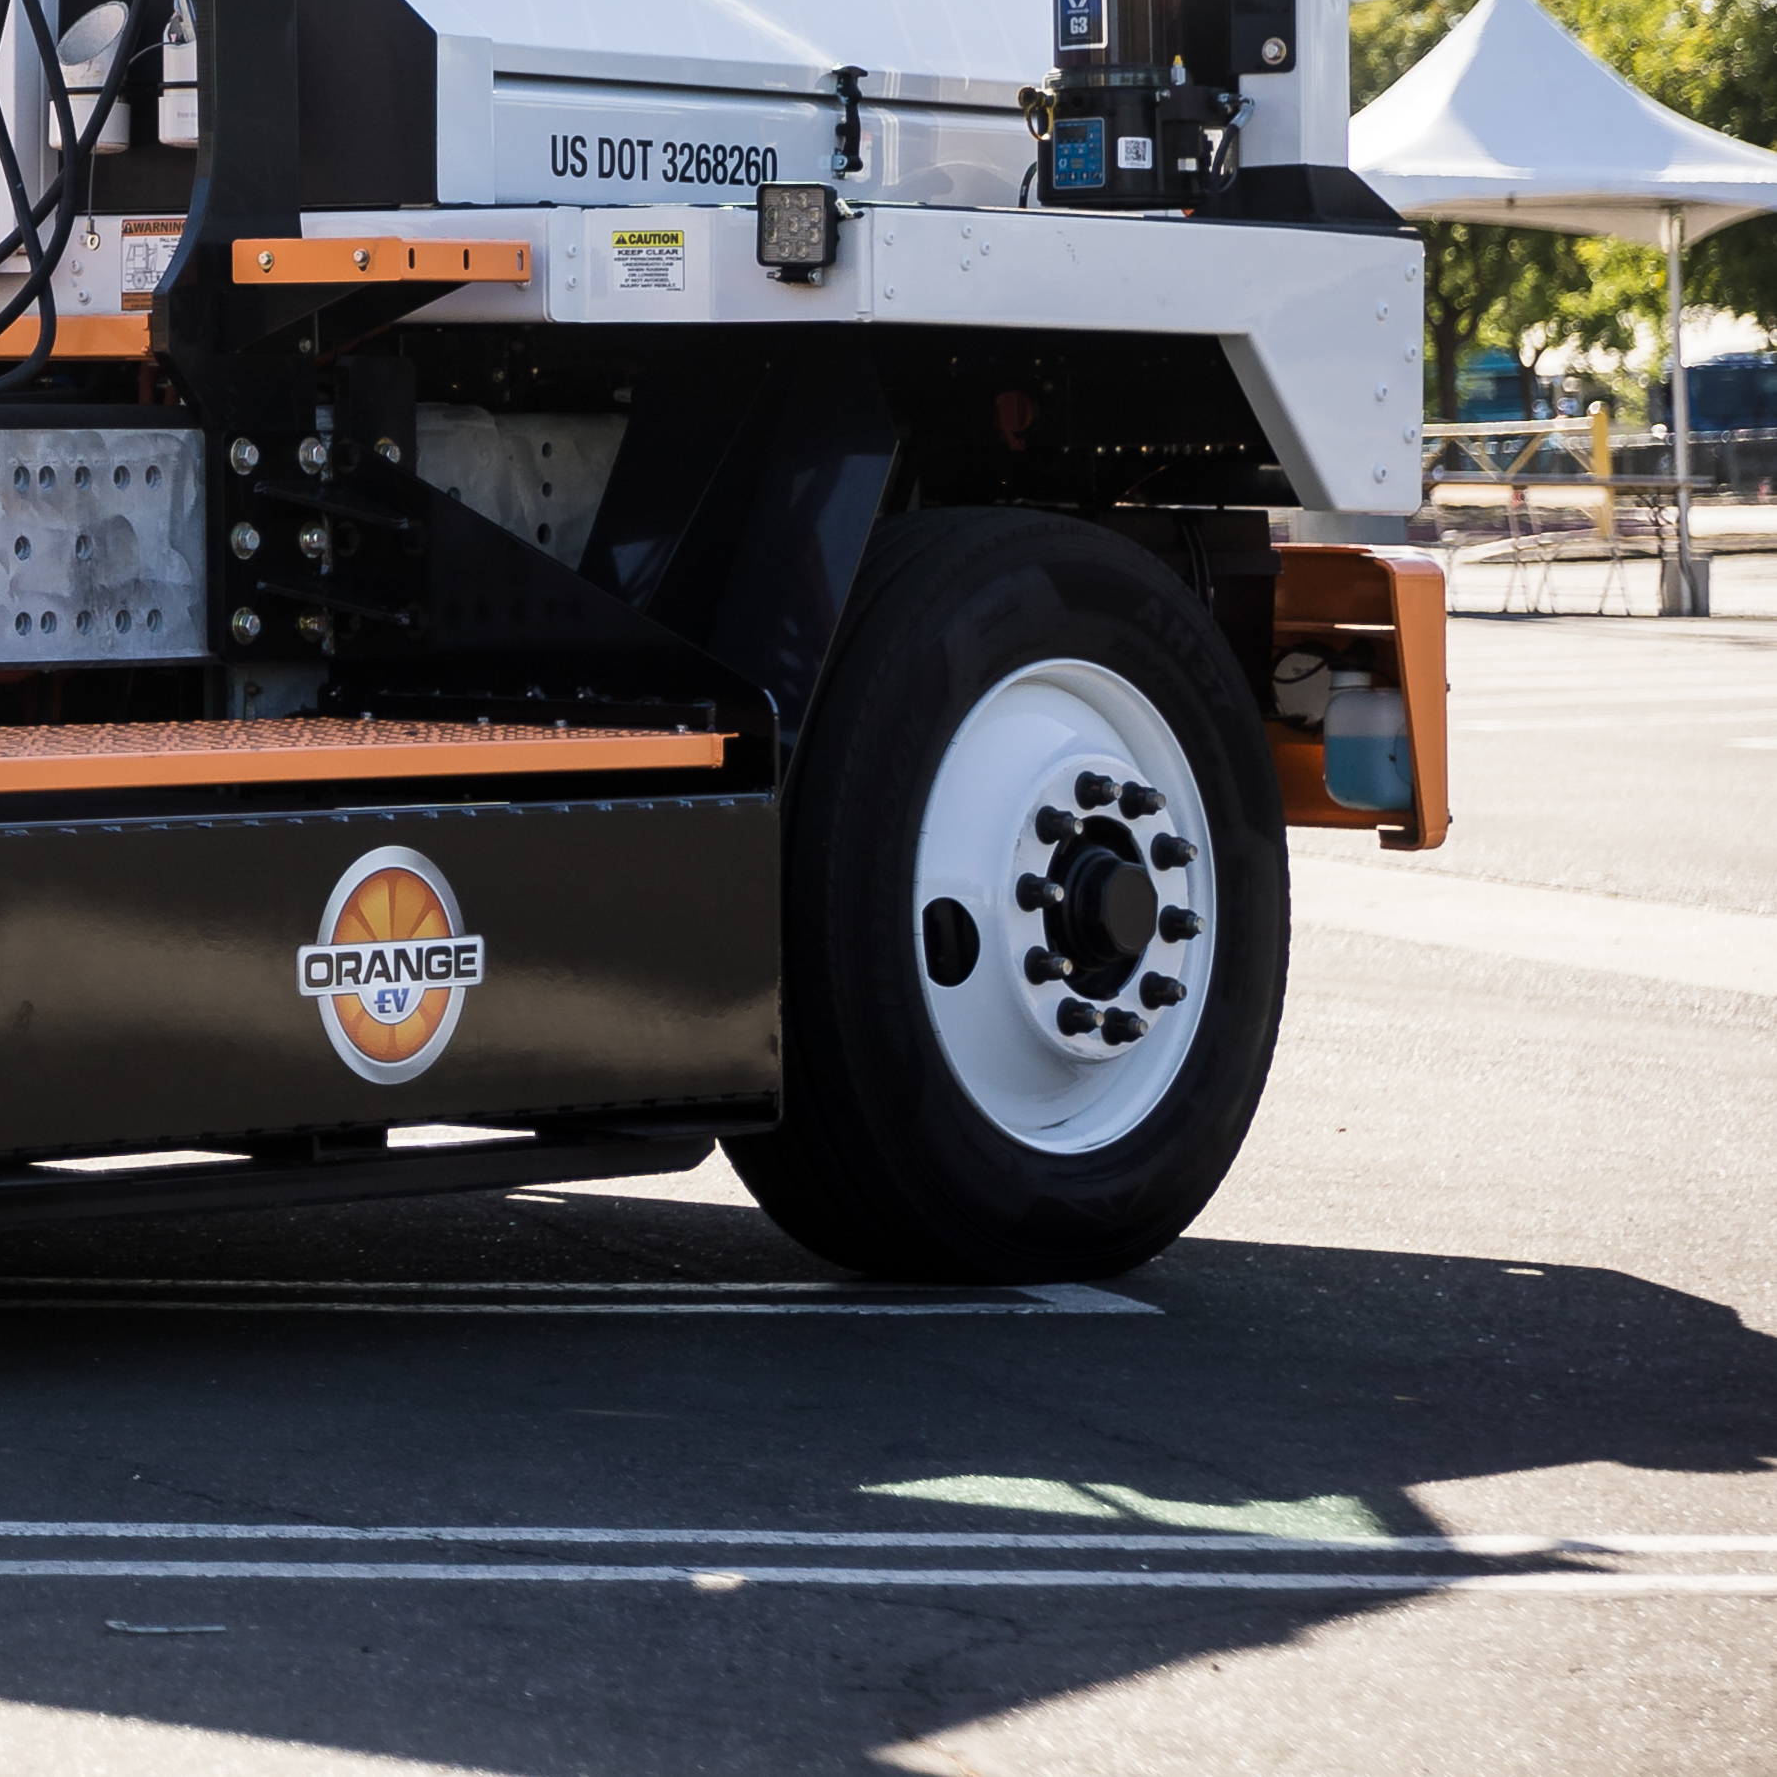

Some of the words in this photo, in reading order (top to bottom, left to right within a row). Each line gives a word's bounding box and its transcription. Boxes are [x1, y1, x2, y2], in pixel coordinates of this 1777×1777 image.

[1070, 16, 1088, 34] G3
[551, 134, 588, 178] US
[598, 137, 653, 181] DOT
[661, 141, 778, 186] 3268260
[628, 233, 679, 245] CAUTION
[305, 944, 478, 988] ORANGE
[374, 988, 410, 1014] EV
